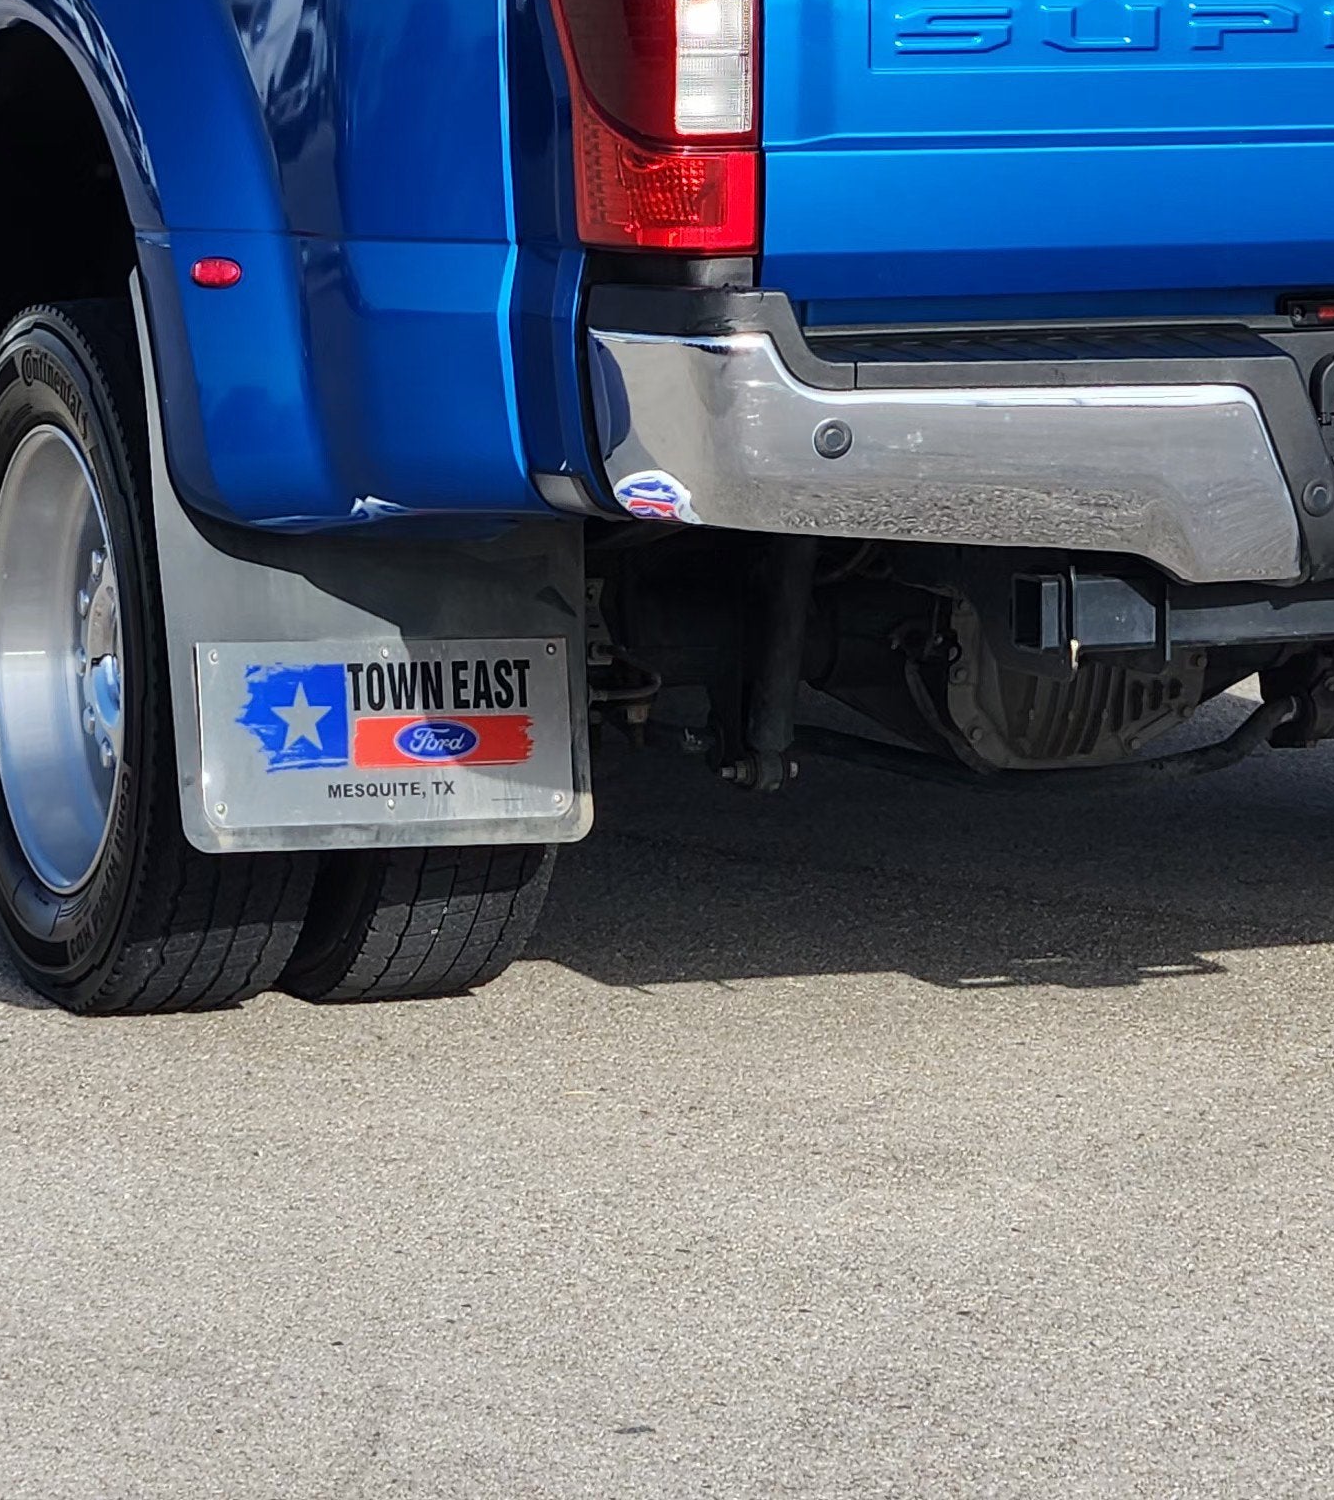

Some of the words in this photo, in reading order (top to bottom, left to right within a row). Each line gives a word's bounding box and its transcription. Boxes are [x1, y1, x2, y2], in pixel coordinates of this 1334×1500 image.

[22, 348, 83, 427] Continental
[347, 661, 445, 712] TOWN
[452, 658, 532, 710] EAST
[407, 726, 466, 754] Ford
[327, 781, 427, 800] MESQUITE,
[432, 780, 456, 797] TX
